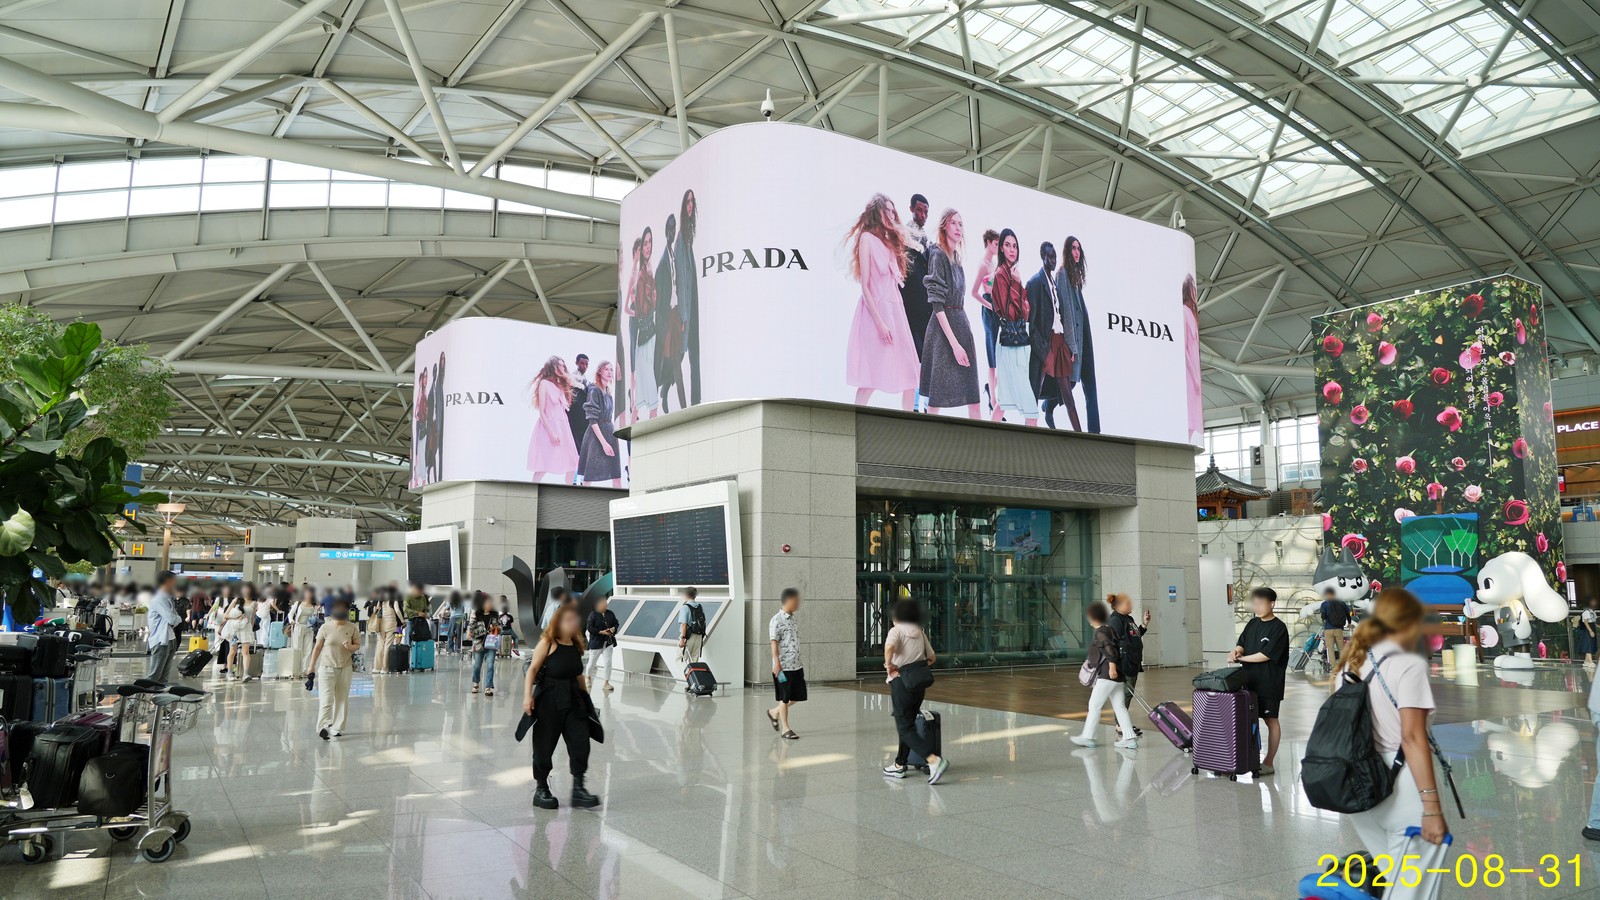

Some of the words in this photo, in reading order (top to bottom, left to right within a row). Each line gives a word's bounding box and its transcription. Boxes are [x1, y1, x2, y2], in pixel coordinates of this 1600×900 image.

[702, 247, 809, 278] PRADA
[1107, 313, 1174, 342] PRADA
[444, 391, 504, 407] PRADA
[1482, 404, 1492, 429] 이윽고
[1556, 421, 1599, 433] PLACE
[131, 543, 145, 556] H
